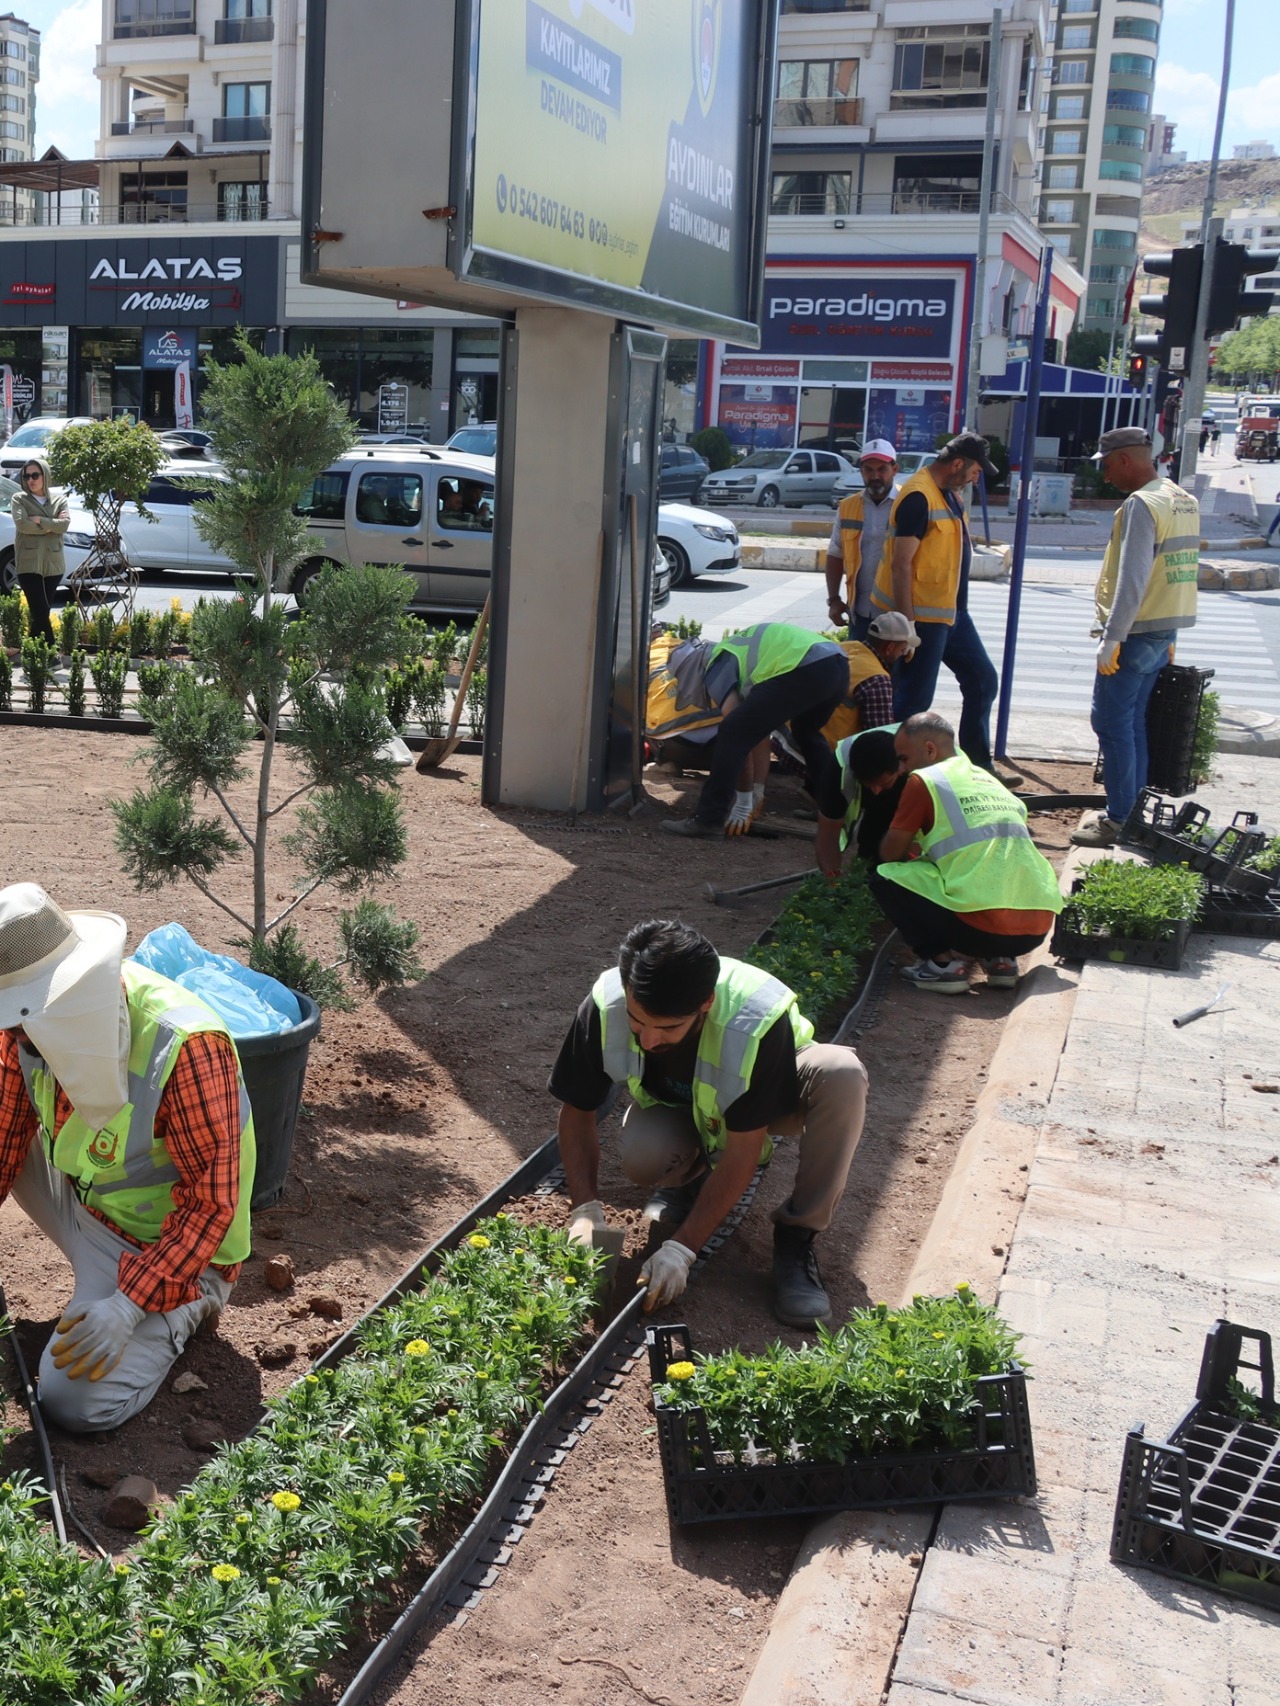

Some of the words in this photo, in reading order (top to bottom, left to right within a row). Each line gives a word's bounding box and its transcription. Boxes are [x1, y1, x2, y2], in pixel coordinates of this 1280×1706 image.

[541, 17, 611, 95] KAYITLARIMIZ
[541, 79, 575, 127] DEVAM
[668, 136, 733, 210] AYDINLAR
[510, 184, 518, 214] 0
[519, 187, 538, 222] 542
[540, 196, 558, 229] 607
[560, 205, 572, 234] 64
[573, 210, 585, 239] 63
[89, 257, 242, 281] ALATAŞ
[121, 292, 210, 311] Mobilya
[770, 290, 946, 321] paradigma
[725, 410, 789, 422] Paradigma
[960, 795, 980, 805] PARK
